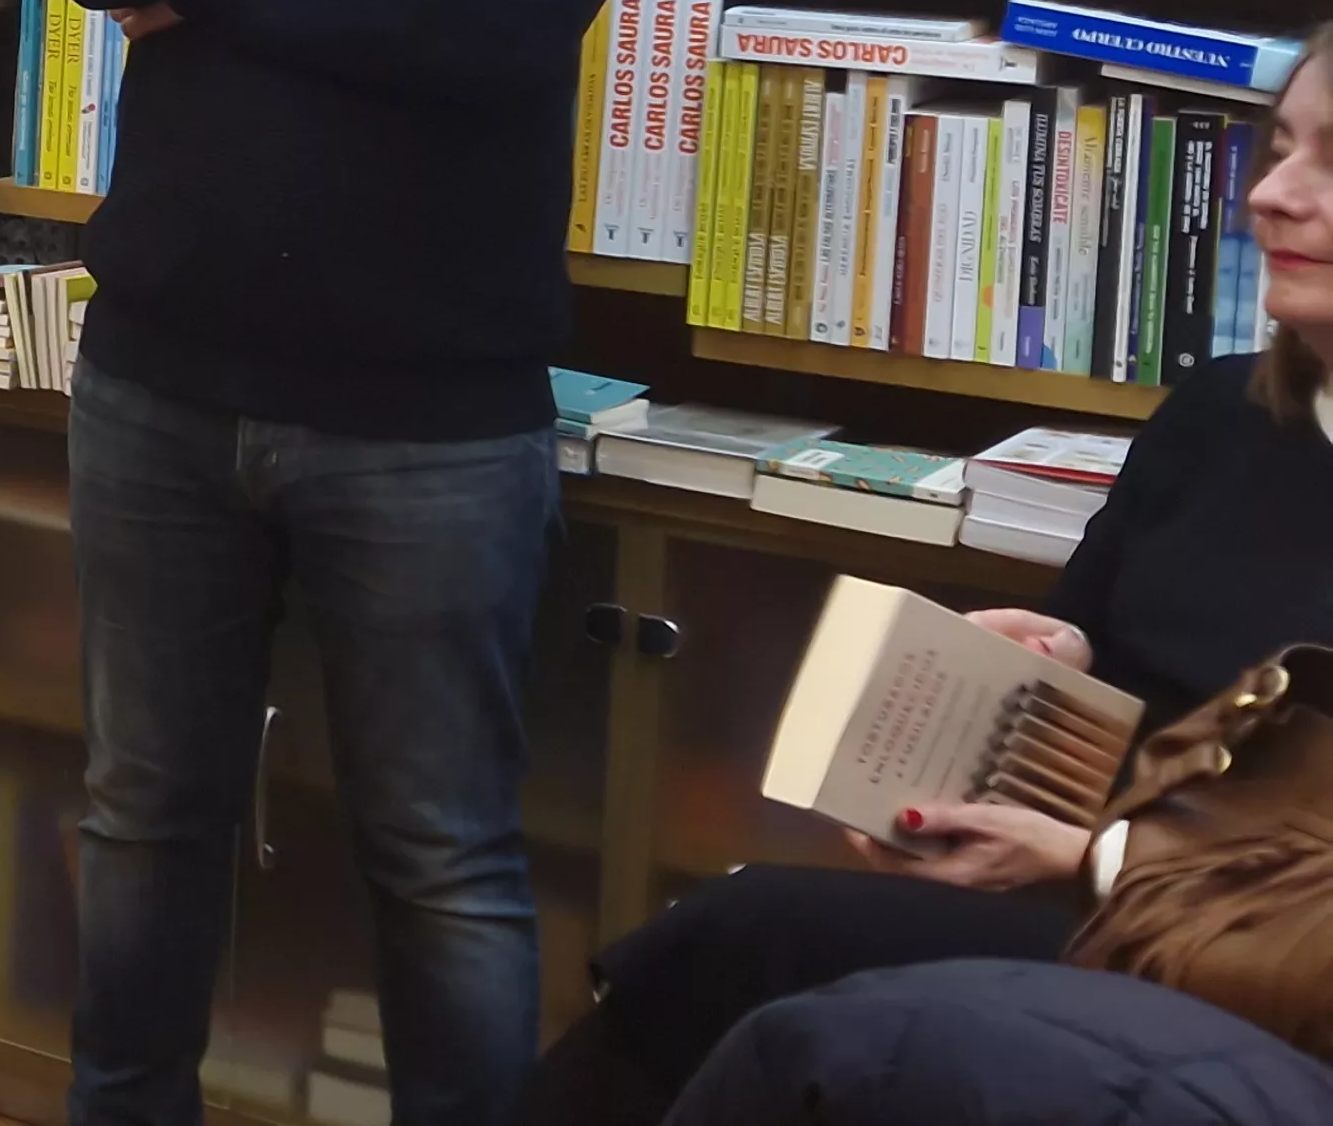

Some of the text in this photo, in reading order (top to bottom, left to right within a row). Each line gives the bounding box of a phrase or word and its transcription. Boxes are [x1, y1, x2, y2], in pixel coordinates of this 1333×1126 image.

[47, 12, 61, 62] DYER
[66, 16, 81, 64] DYER
[737, 32, 910, 66] CARLOS SAURA
[1072, 27, 1231, 68] NUESTRO CUERPO
[643, 0, 677, 151] CARLOS SAURA
[678, 1, 712, 154] CARLOS SAURA
[609, 68, 636, 149] CARLOS
[1033, 113, 1049, 163] ILUMINA
[1031, 164, 1046, 187] TUS
[959, 210, 978, 282] DIGNIDAD
